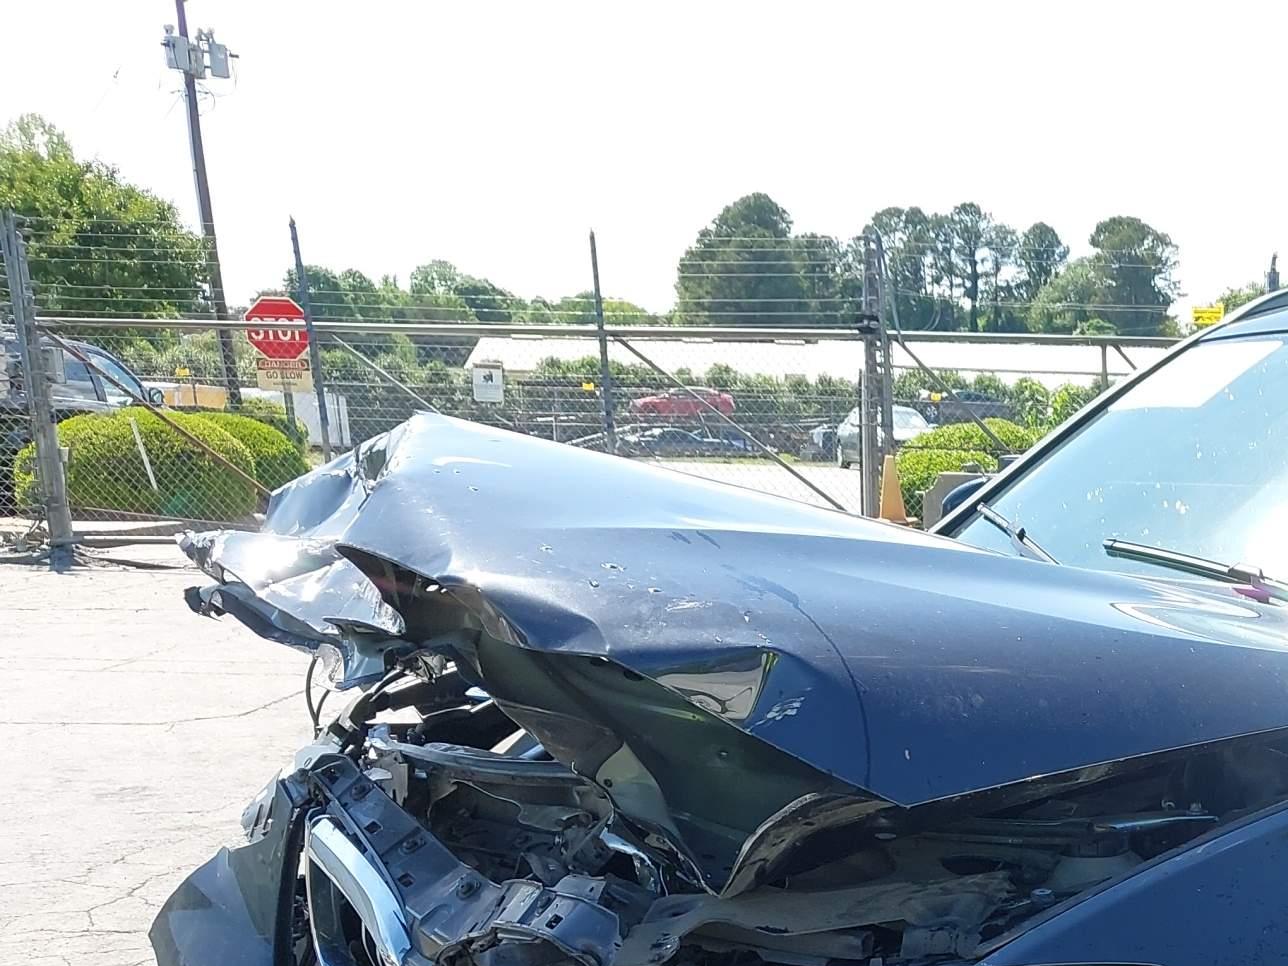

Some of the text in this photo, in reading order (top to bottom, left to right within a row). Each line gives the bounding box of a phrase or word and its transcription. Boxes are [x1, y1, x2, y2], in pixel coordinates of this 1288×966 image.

[250, 317, 305, 341] STOP
[266, 371, 303, 380] GO SLOW
